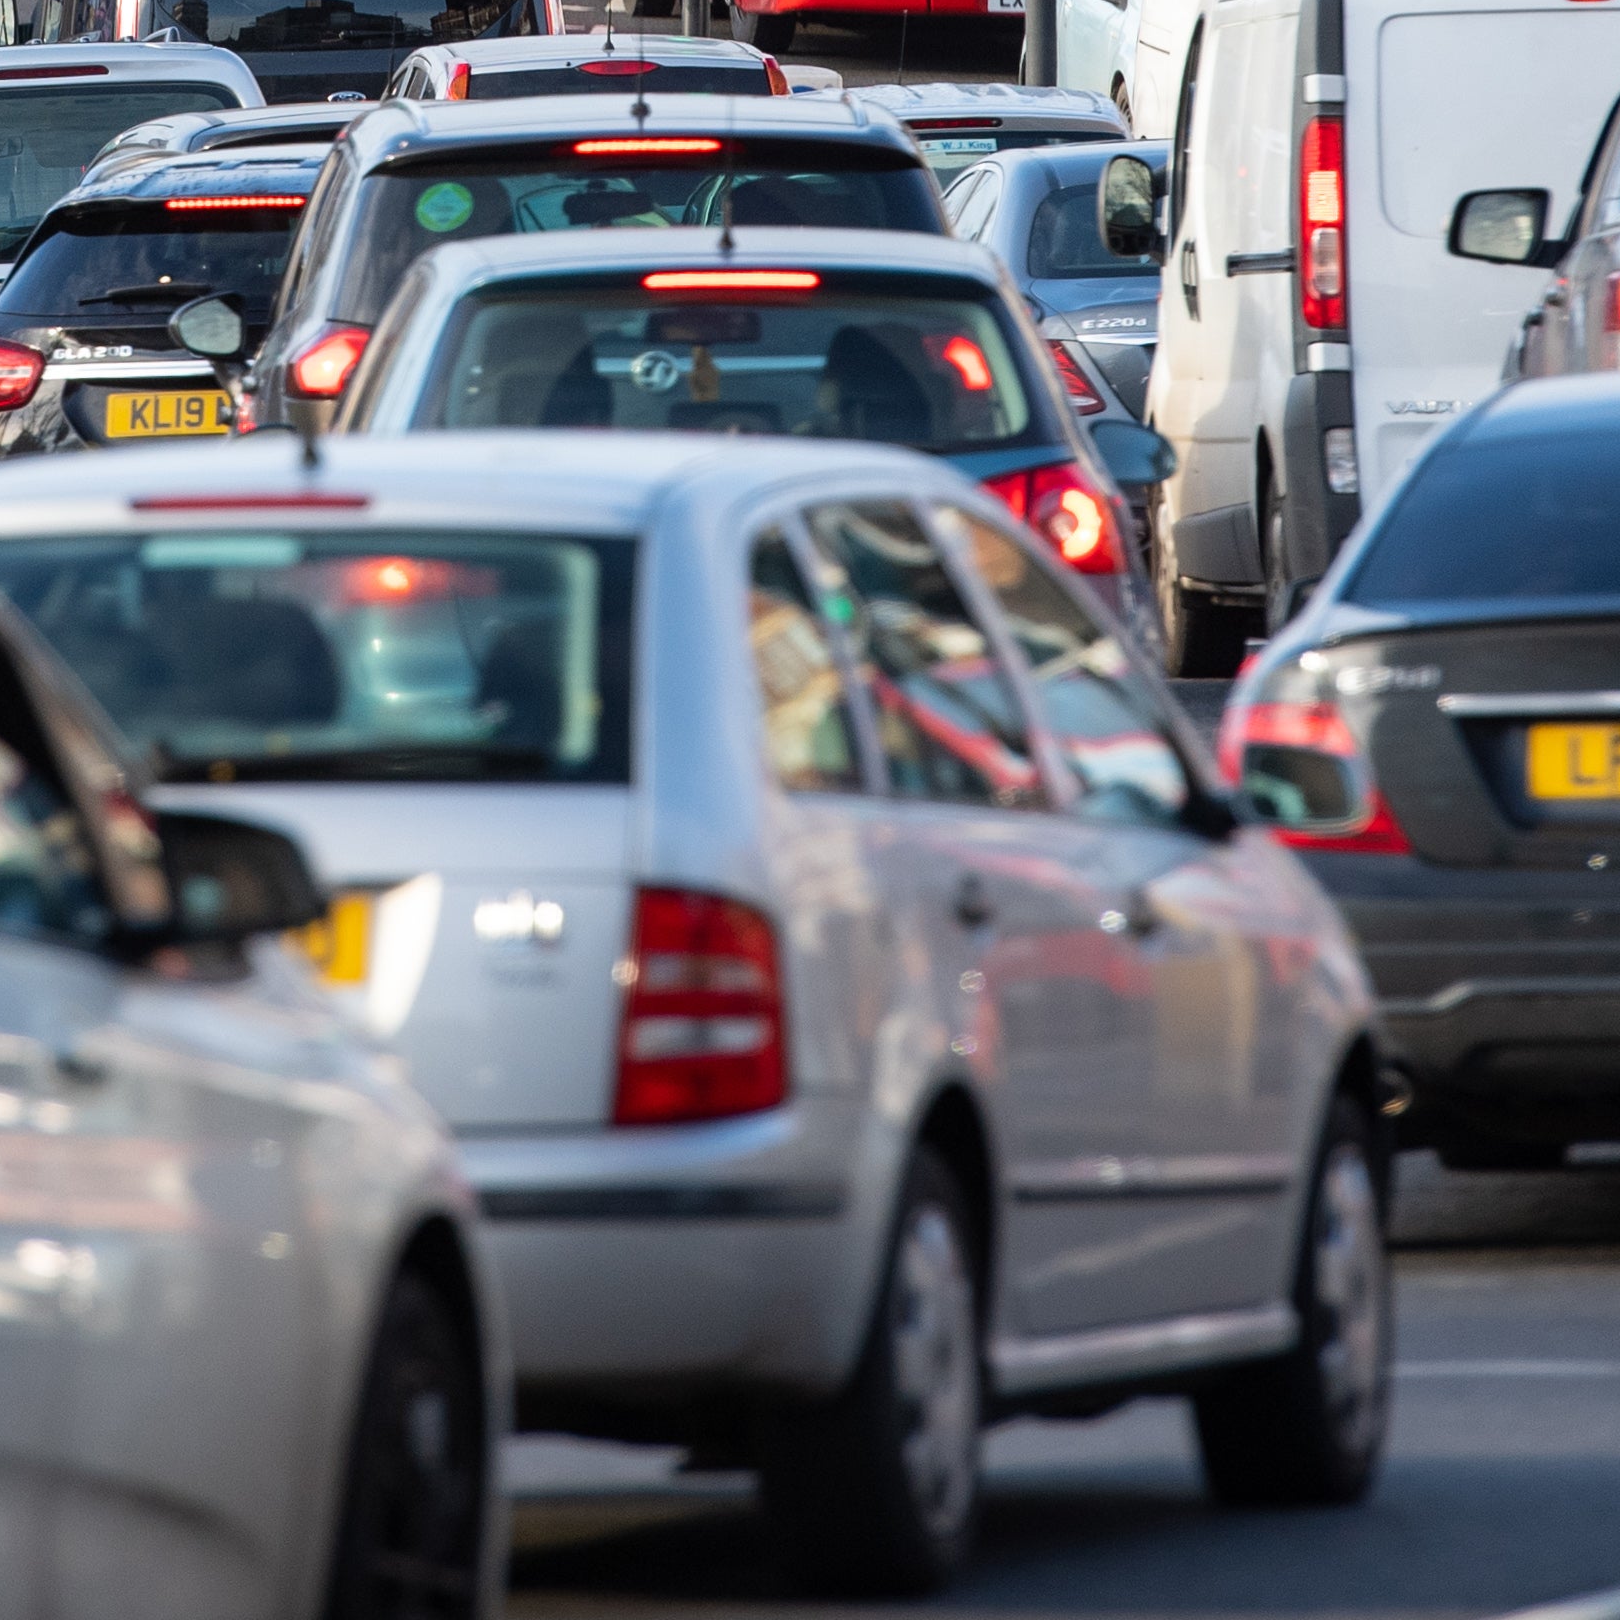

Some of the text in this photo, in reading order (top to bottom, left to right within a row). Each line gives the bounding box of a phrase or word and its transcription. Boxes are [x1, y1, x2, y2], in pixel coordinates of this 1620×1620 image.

[968, 141, 993, 151] King
[53, 345, 91, 360] GLA
[130, 396, 205, 431] KL19
